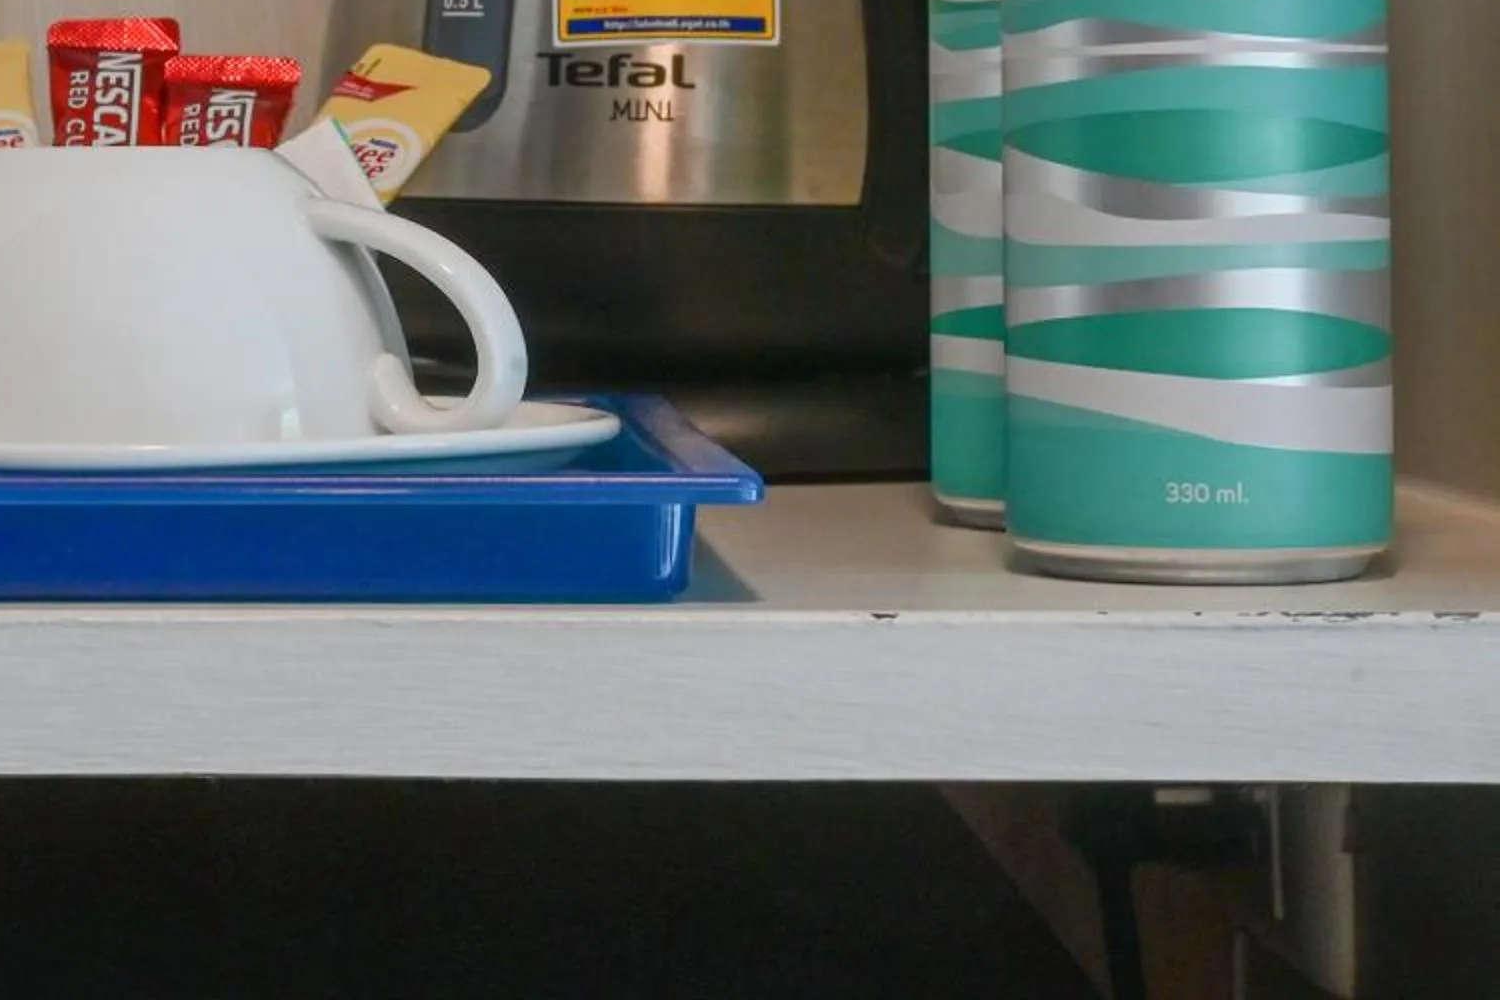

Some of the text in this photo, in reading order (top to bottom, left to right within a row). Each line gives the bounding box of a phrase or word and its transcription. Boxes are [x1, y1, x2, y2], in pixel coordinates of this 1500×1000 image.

[538, 53, 695, 90] Tefal
[68, 71, 89, 109] RED
[609, 101, 674, 121] MINI
[1165, 481, 1250, 504] 330 ml.
